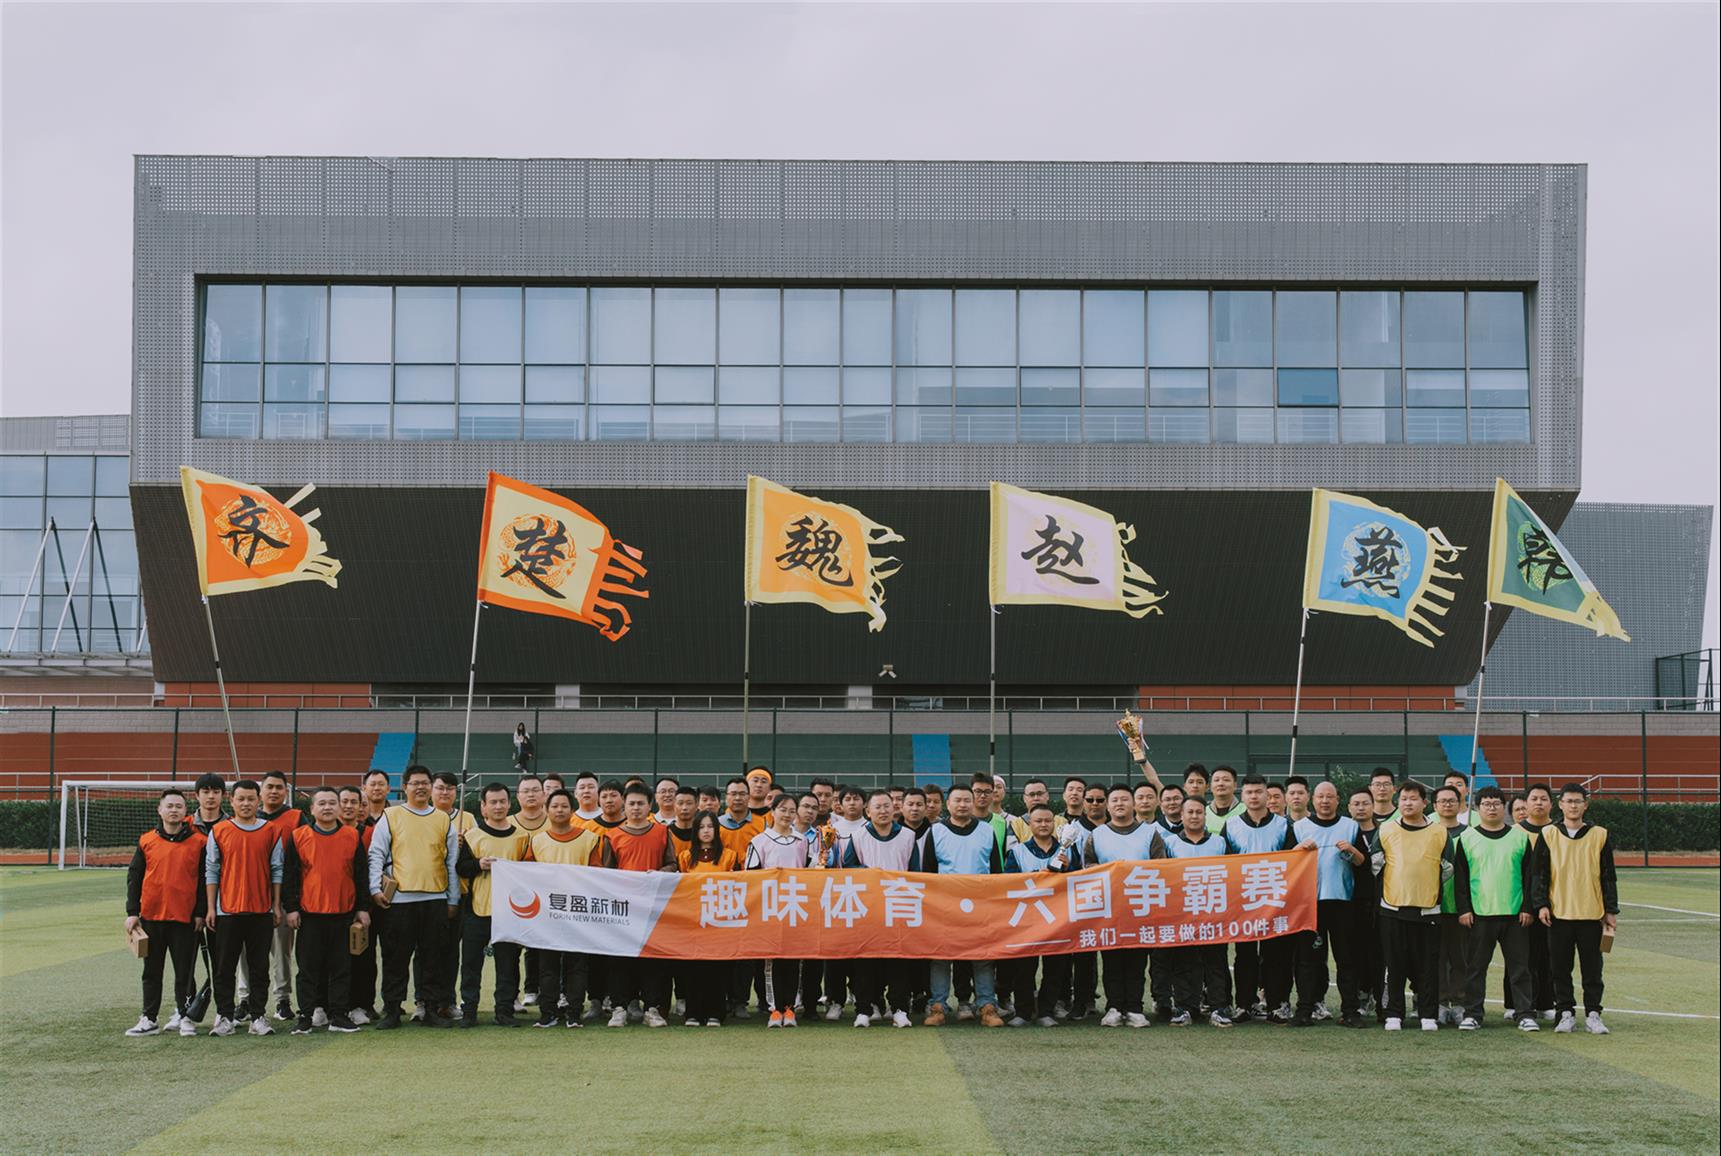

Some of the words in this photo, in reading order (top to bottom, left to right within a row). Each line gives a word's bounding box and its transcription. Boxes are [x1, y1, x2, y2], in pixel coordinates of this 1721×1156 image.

[500, 517, 567, 599] 楚
[775, 515, 854, 587] 魏
[1020, 514, 1100, 585] 赵
[1340, 526, 1403, 599] 燕
[549, 893, 629, 917] 复盈新材
[573, 914, 590, 922] NEW
[591, 915, 630, 926] MATERIALS
[1080, 916, 1289, 948] 我们一起要做的100件事
